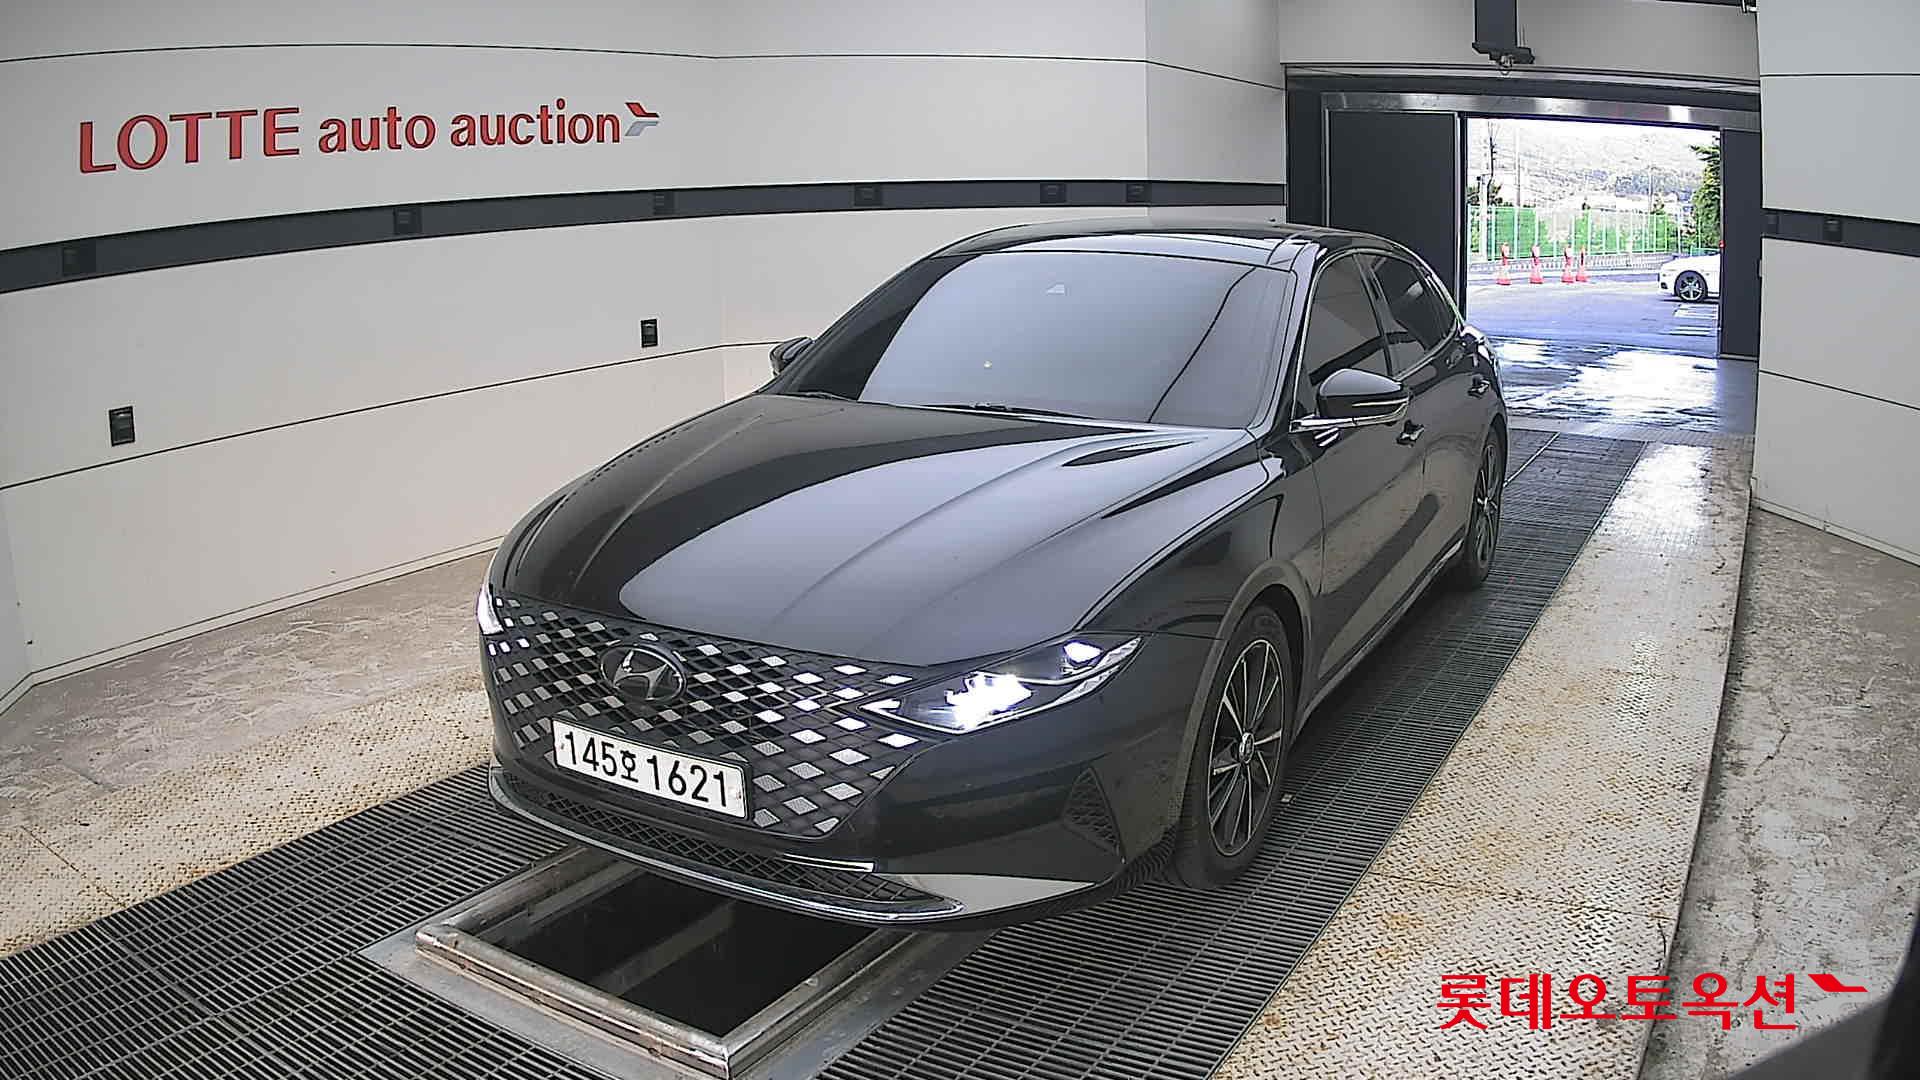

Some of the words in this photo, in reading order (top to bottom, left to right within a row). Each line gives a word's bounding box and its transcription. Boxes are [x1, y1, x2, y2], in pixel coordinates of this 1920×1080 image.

[79, 107, 300, 174] LOTTE
[318, 106, 436, 154] auto
[449, 98, 621, 147] auction
[647, 755, 727, 807] 1621
